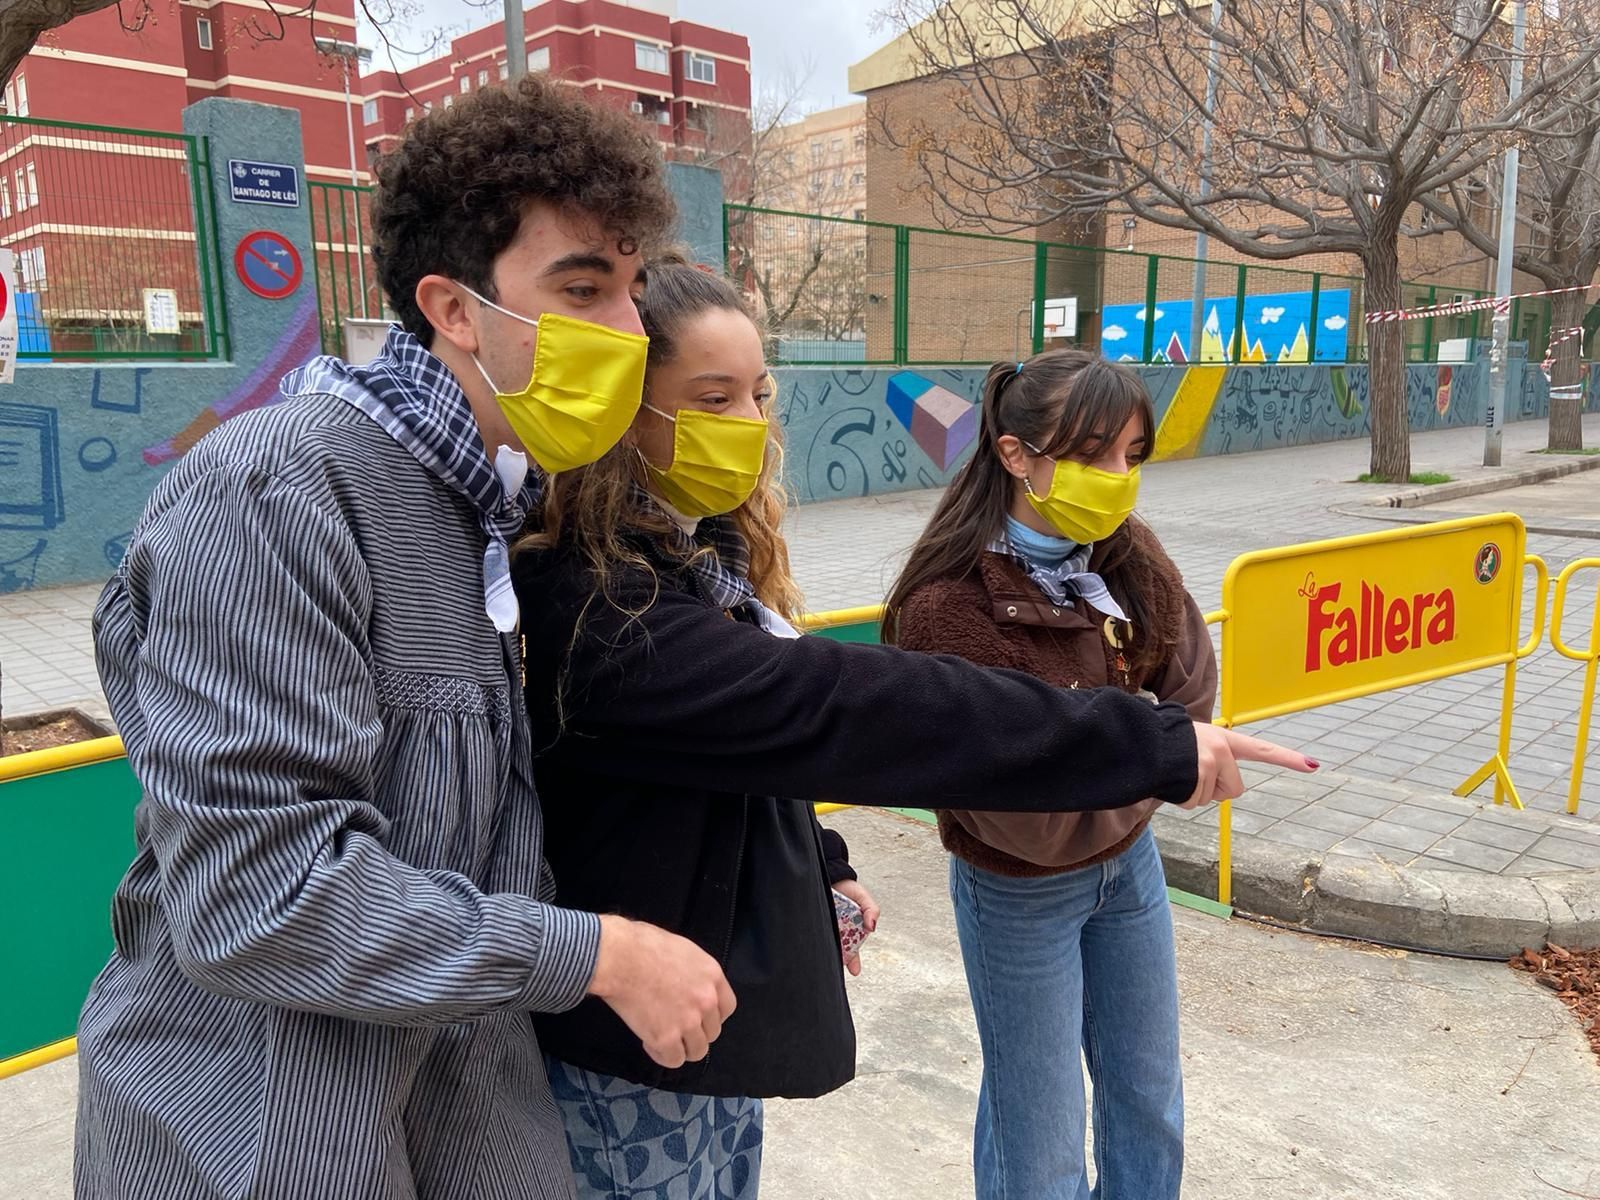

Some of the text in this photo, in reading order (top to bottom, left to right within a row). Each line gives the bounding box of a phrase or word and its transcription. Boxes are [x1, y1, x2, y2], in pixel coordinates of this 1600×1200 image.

[251, 168, 281, 177] CARRER
[234, 187, 271, 198] SANTIAGO
[272, 191, 282, 199] DE
[1298, 571, 1317, 598] La
[1305, 580, 1455, 673] Fallera
